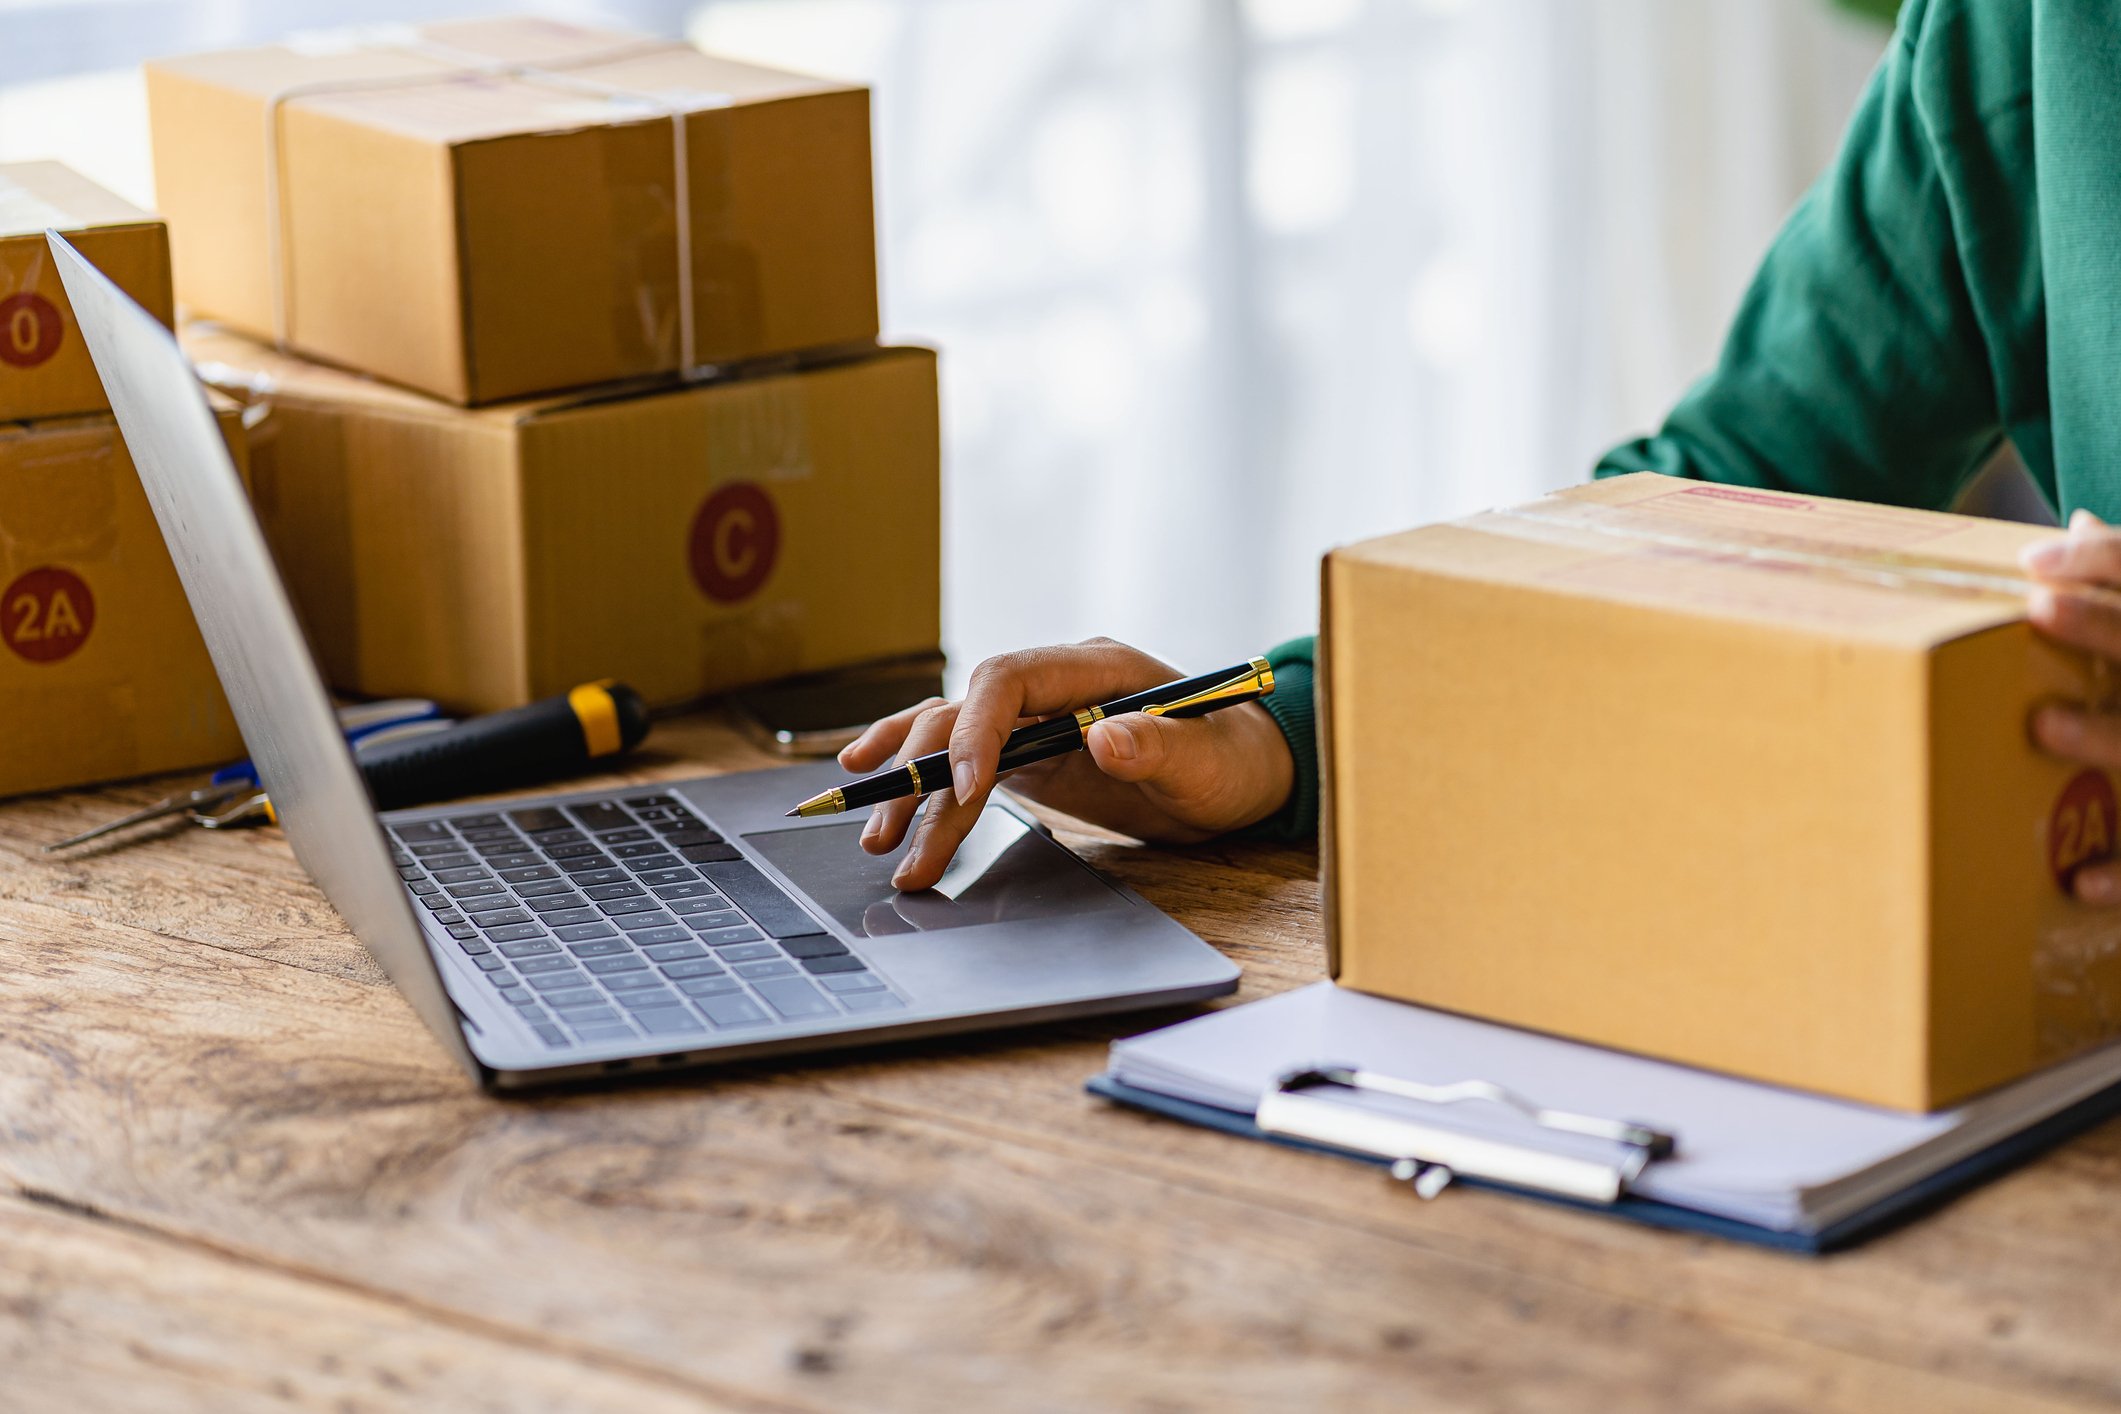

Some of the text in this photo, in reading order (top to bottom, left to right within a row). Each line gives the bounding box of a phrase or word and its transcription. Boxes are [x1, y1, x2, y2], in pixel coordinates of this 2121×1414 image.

[713, 508, 756, 578] C
[12, 589, 82, 642] 2A
[2056, 798, 2108, 868] 2A
